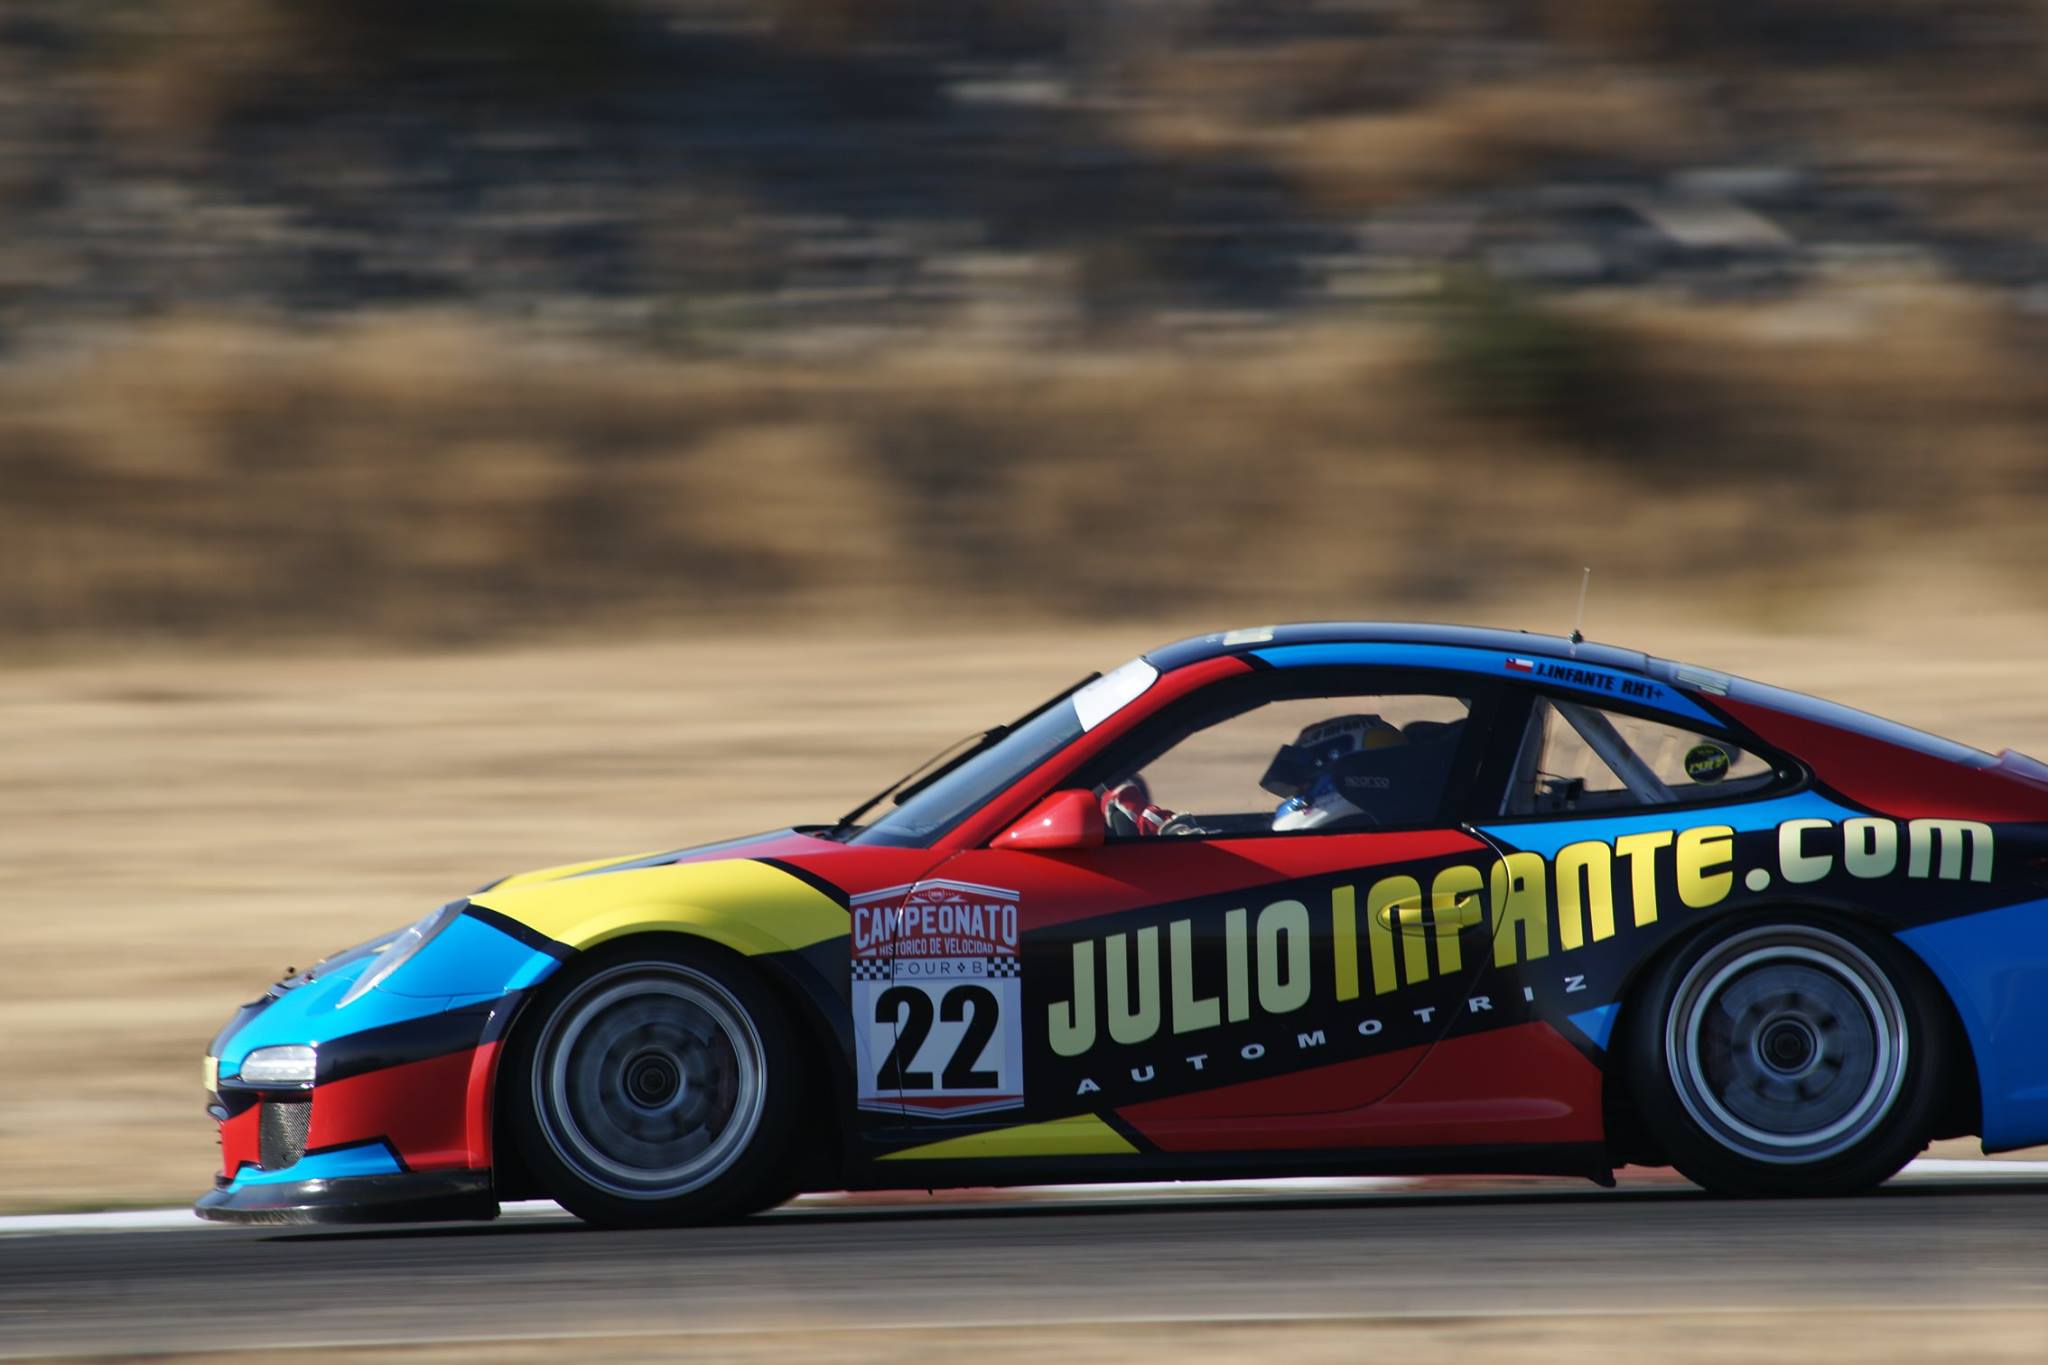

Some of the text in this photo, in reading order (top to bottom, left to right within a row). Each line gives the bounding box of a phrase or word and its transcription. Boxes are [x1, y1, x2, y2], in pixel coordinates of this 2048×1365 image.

[1535, 662, 1616, 691] J.INFANTE
[854, 904, 1018, 950] CAMPEONATO
[929, 937, 942, 954] DE
[943, 937, 994, 956] VELOCIDAD
[895, 961, 951, 975] FOUR
[1048, 899, 1311, 1057] JULIO
[875, 984, 999, 1091] 22
[1076, 974, 1587, 1095] AUTOMOTRIZ
